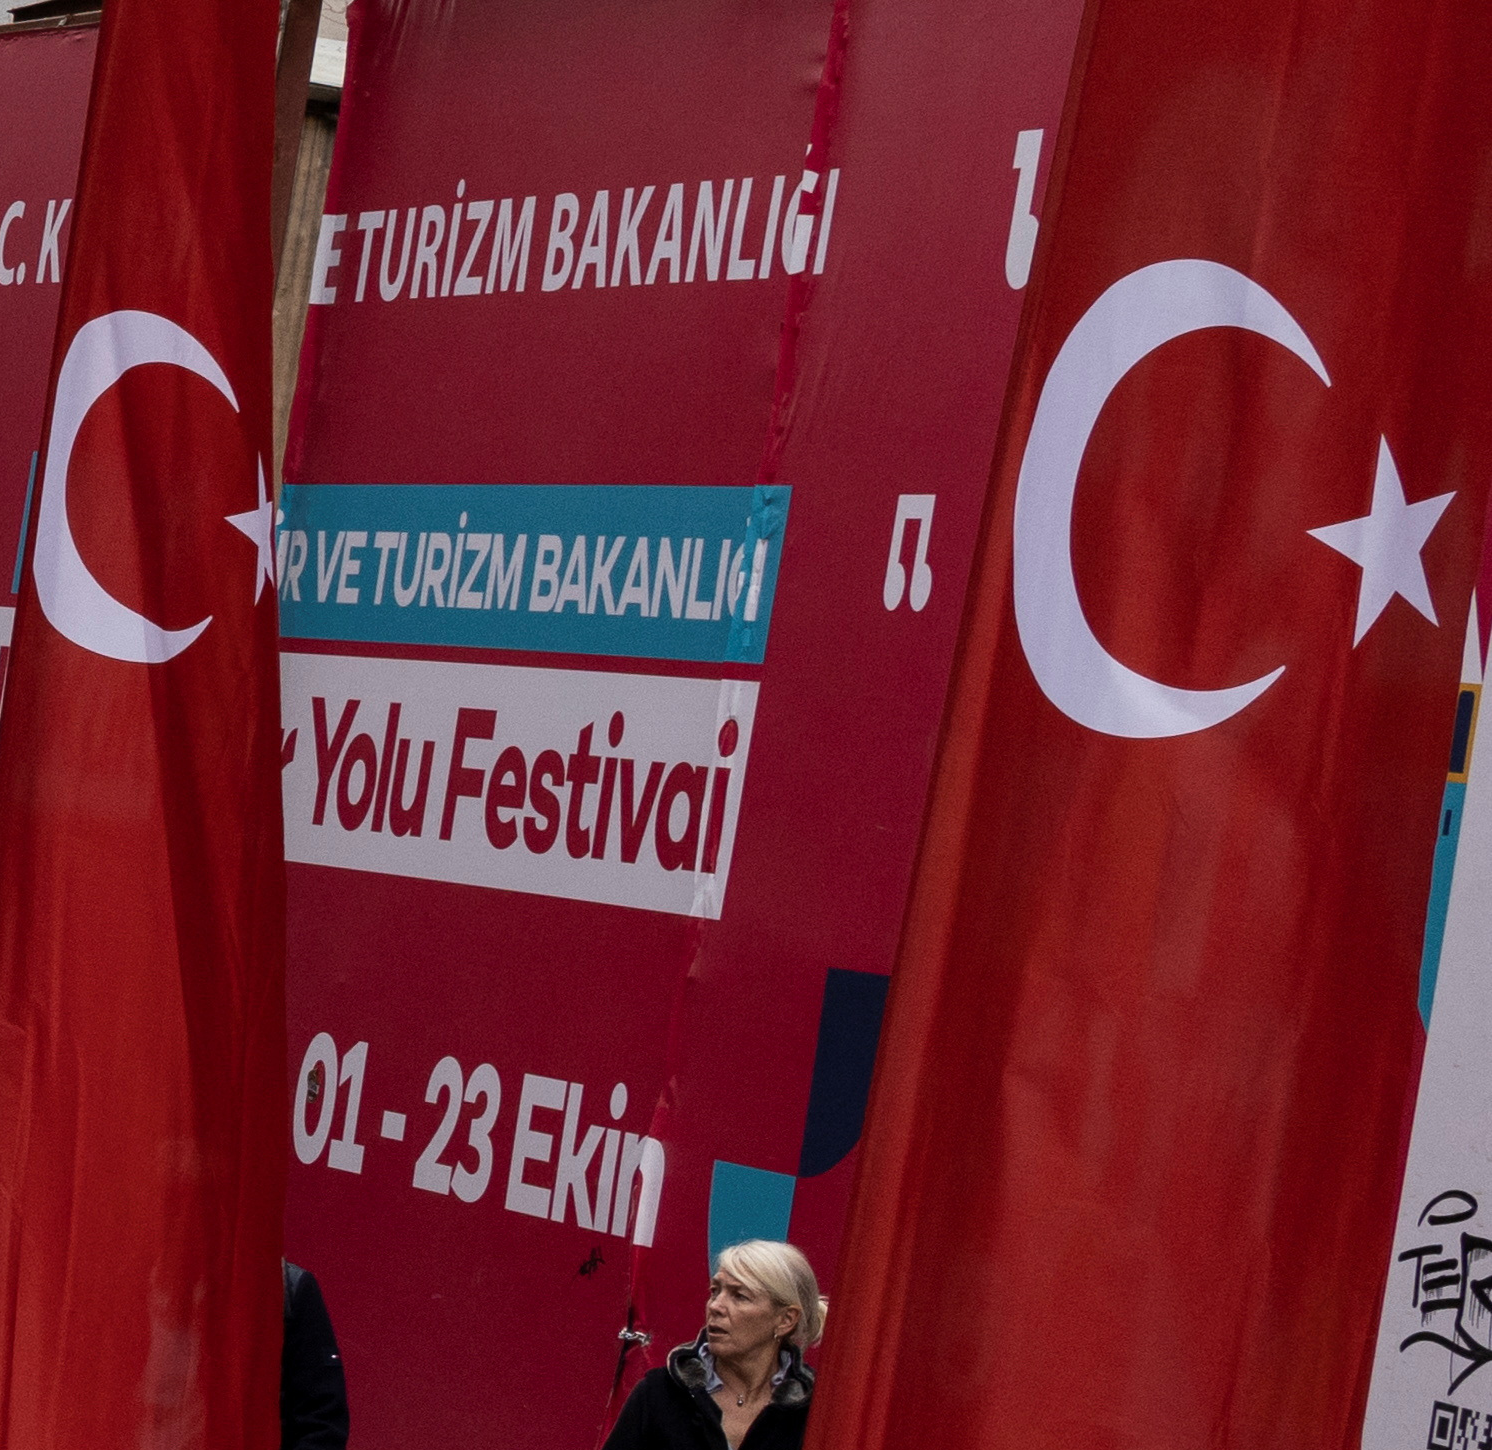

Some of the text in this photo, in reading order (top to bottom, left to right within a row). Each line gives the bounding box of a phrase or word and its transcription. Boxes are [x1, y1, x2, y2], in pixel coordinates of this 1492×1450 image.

[308, 143, 840, 306] E TURİZM BAKANLIĞI
[317, 530, 369, 605] VE
[373, 511, 528, 612] TURİZM
[311, 696, 436, 838] Yolu
[293, 1031, 368, 1175] 01
[413, 1055, 502, 1203] 23
